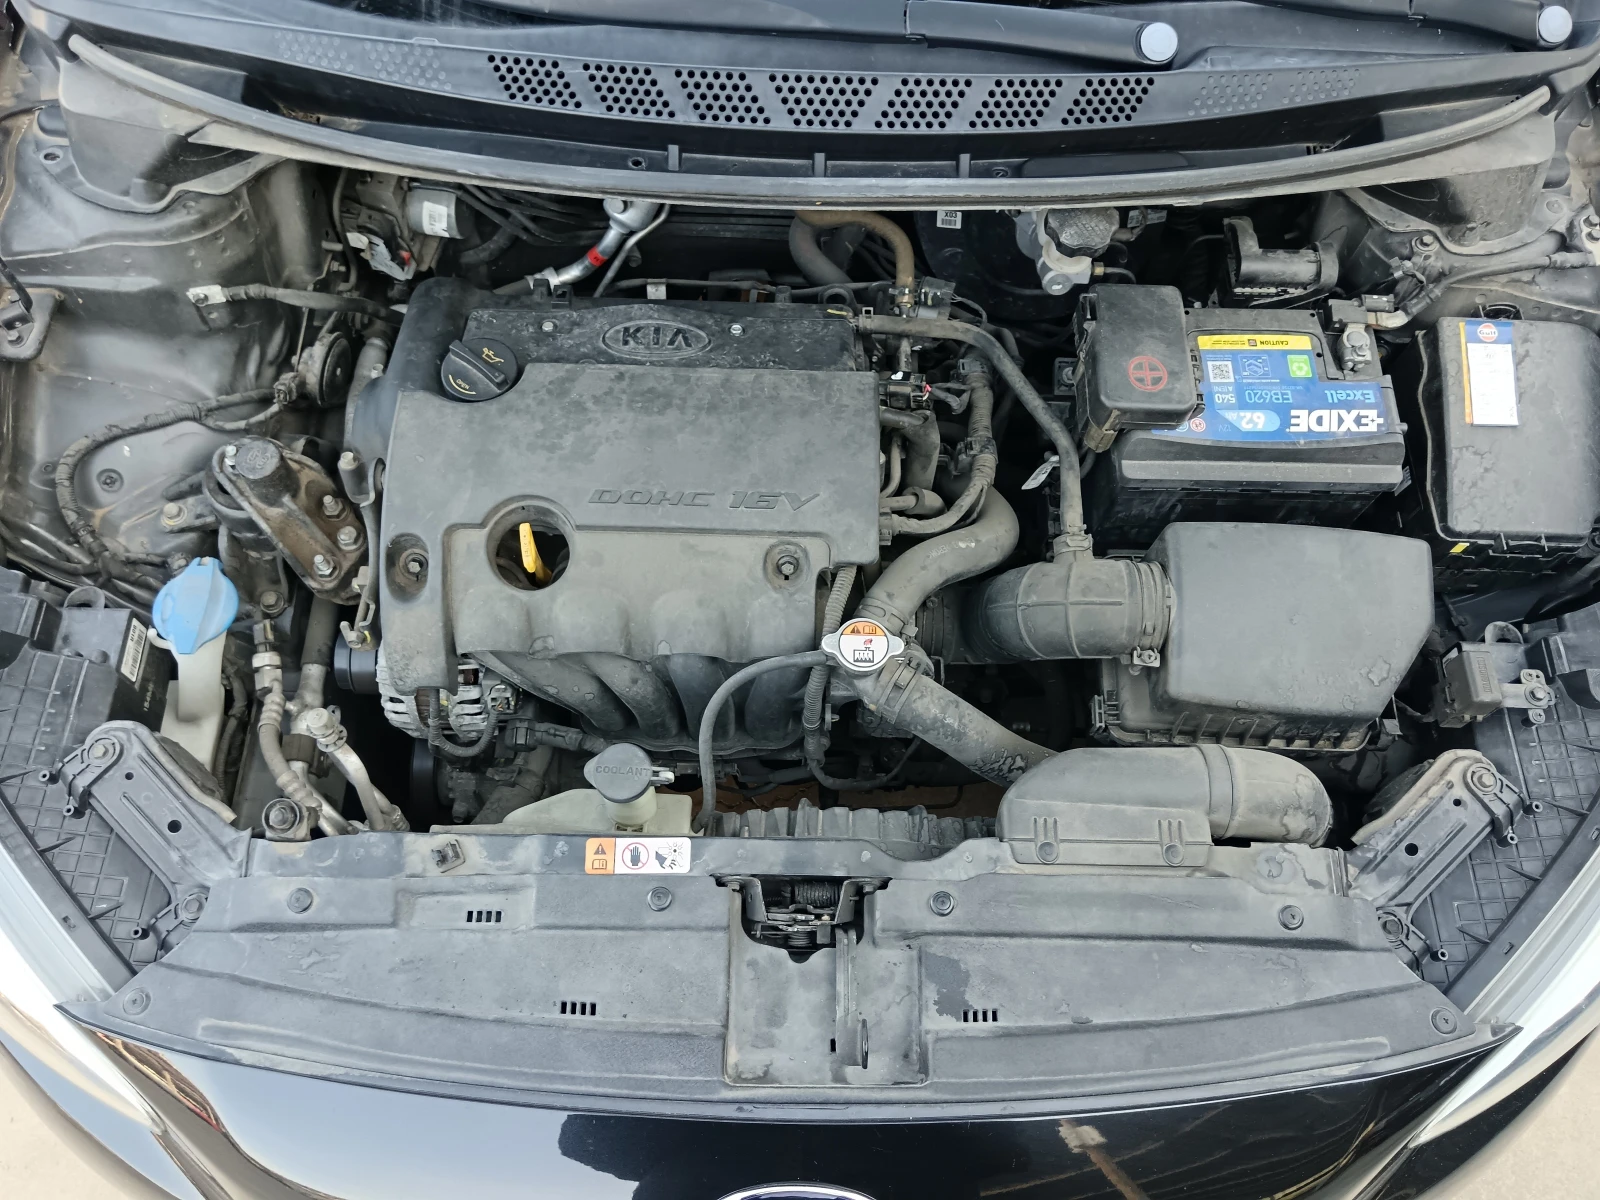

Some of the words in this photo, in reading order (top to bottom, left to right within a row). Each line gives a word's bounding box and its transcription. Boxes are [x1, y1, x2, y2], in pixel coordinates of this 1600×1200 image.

[620, 325, 694, 348] KIA
[456, 378, 470, 390] OPEN
[1214, 393, 1236, 403] 540
[1245, 390, 1293, 403] EB620
[1325, 389, 1376, 403] Excell
[1240, 411, 1266, 429] 62
[1289, 409, 1384, 432] EXIDE
[588, 488, 715, 507] DOHC
[728, 489, 821, 512] 16V
[595, 765, 651, 777] COOLANT
